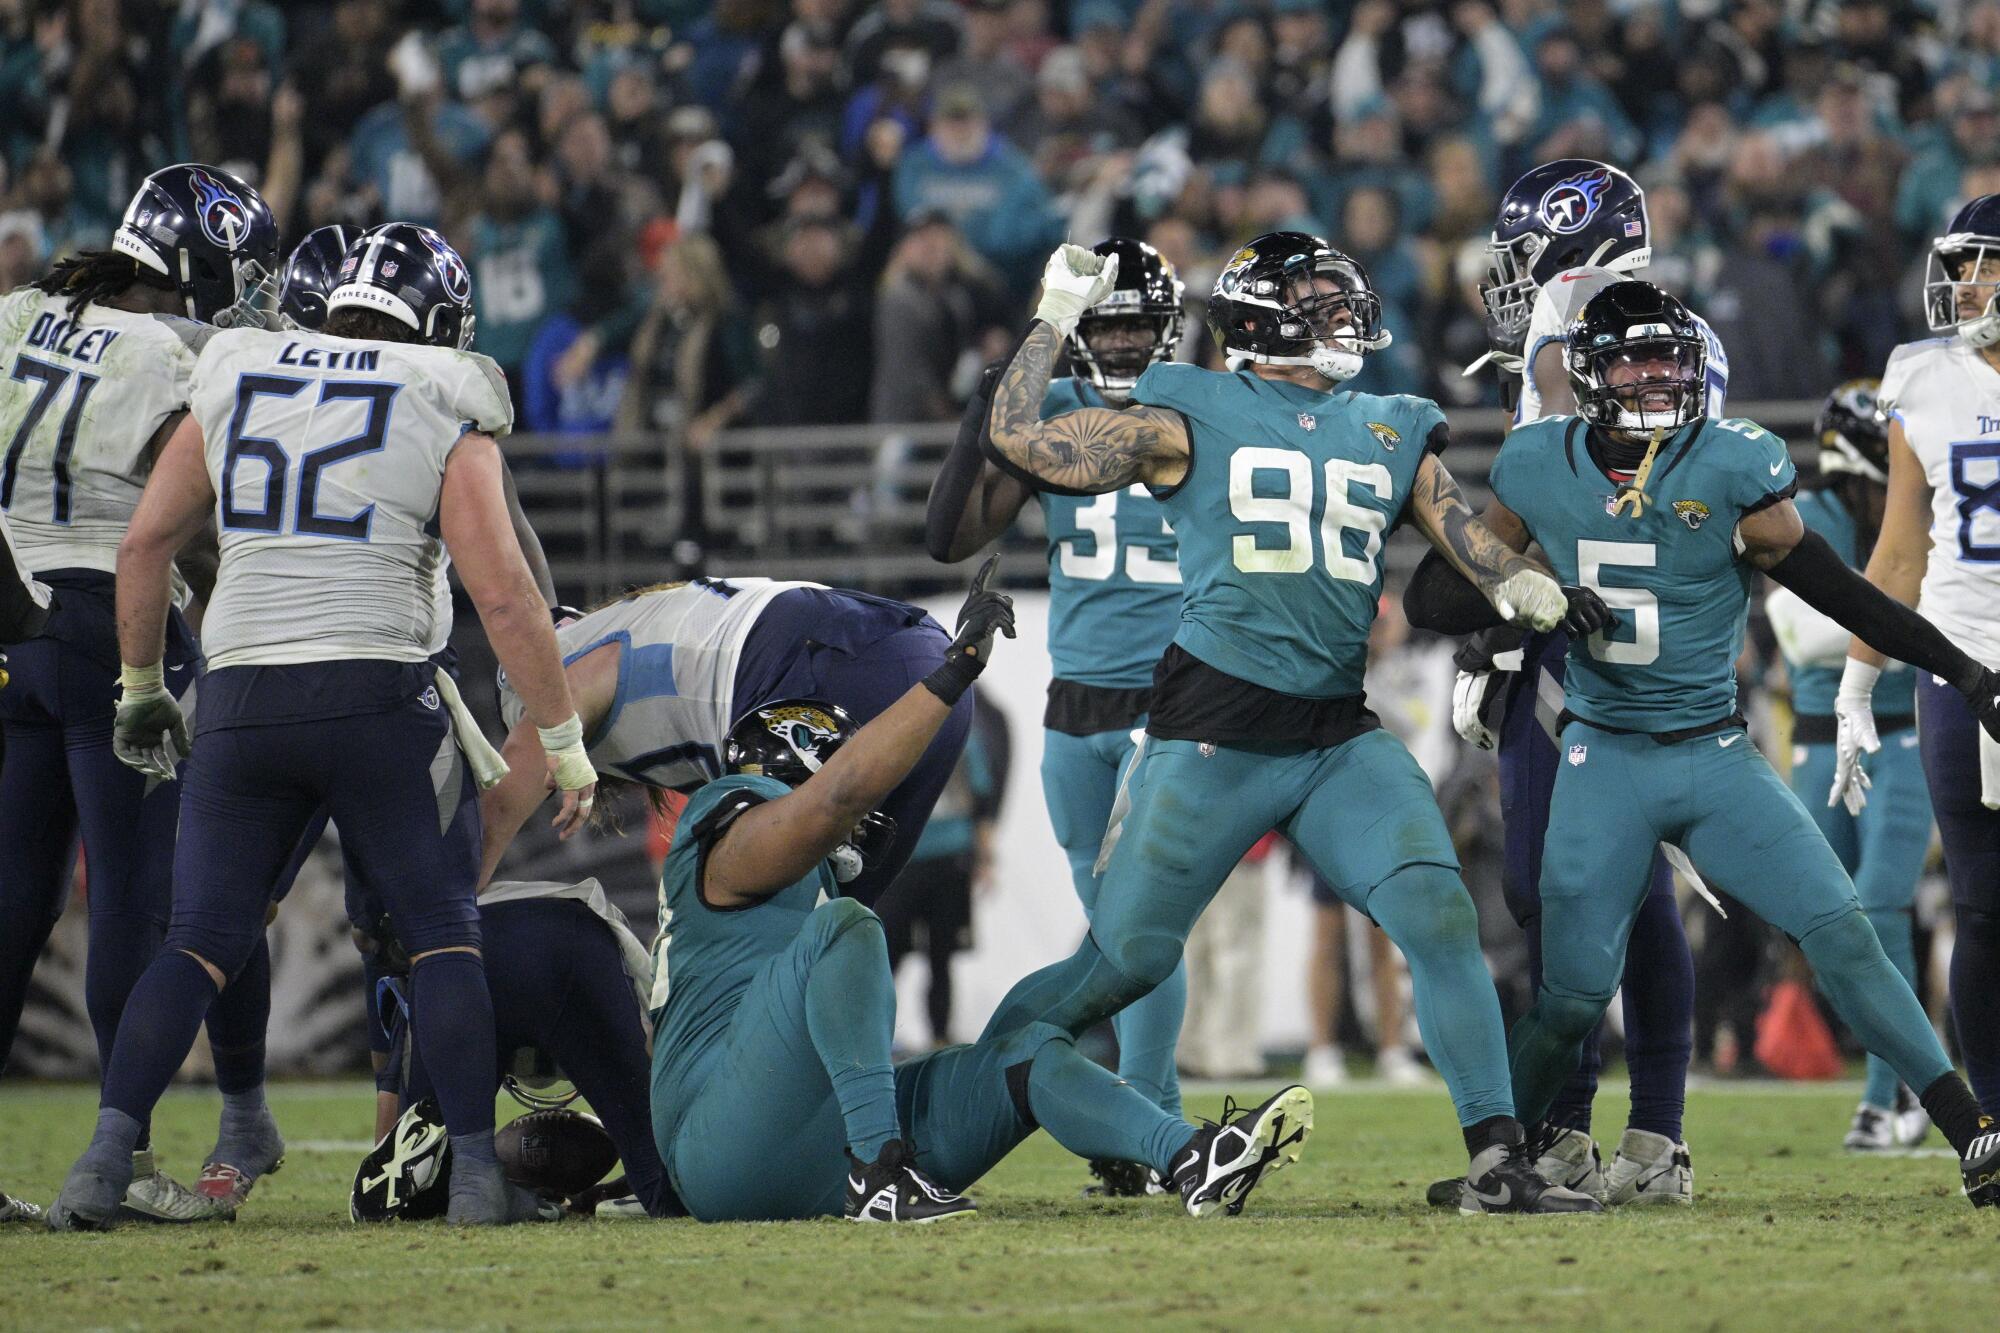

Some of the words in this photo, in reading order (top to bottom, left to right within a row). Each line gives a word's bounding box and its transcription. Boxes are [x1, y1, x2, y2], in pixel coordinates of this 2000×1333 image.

[26, 310, 120, 364] DALEY
[276, 341, 381, 371] LEVIN
[332, 291, 393, 307] TENNESSEE
[0, 352, 102, 527] 71
[221, 372, 407, 542] 62
[1229, 446, 1393, 586] 96
[1578, 539, 1659, 665] 5
